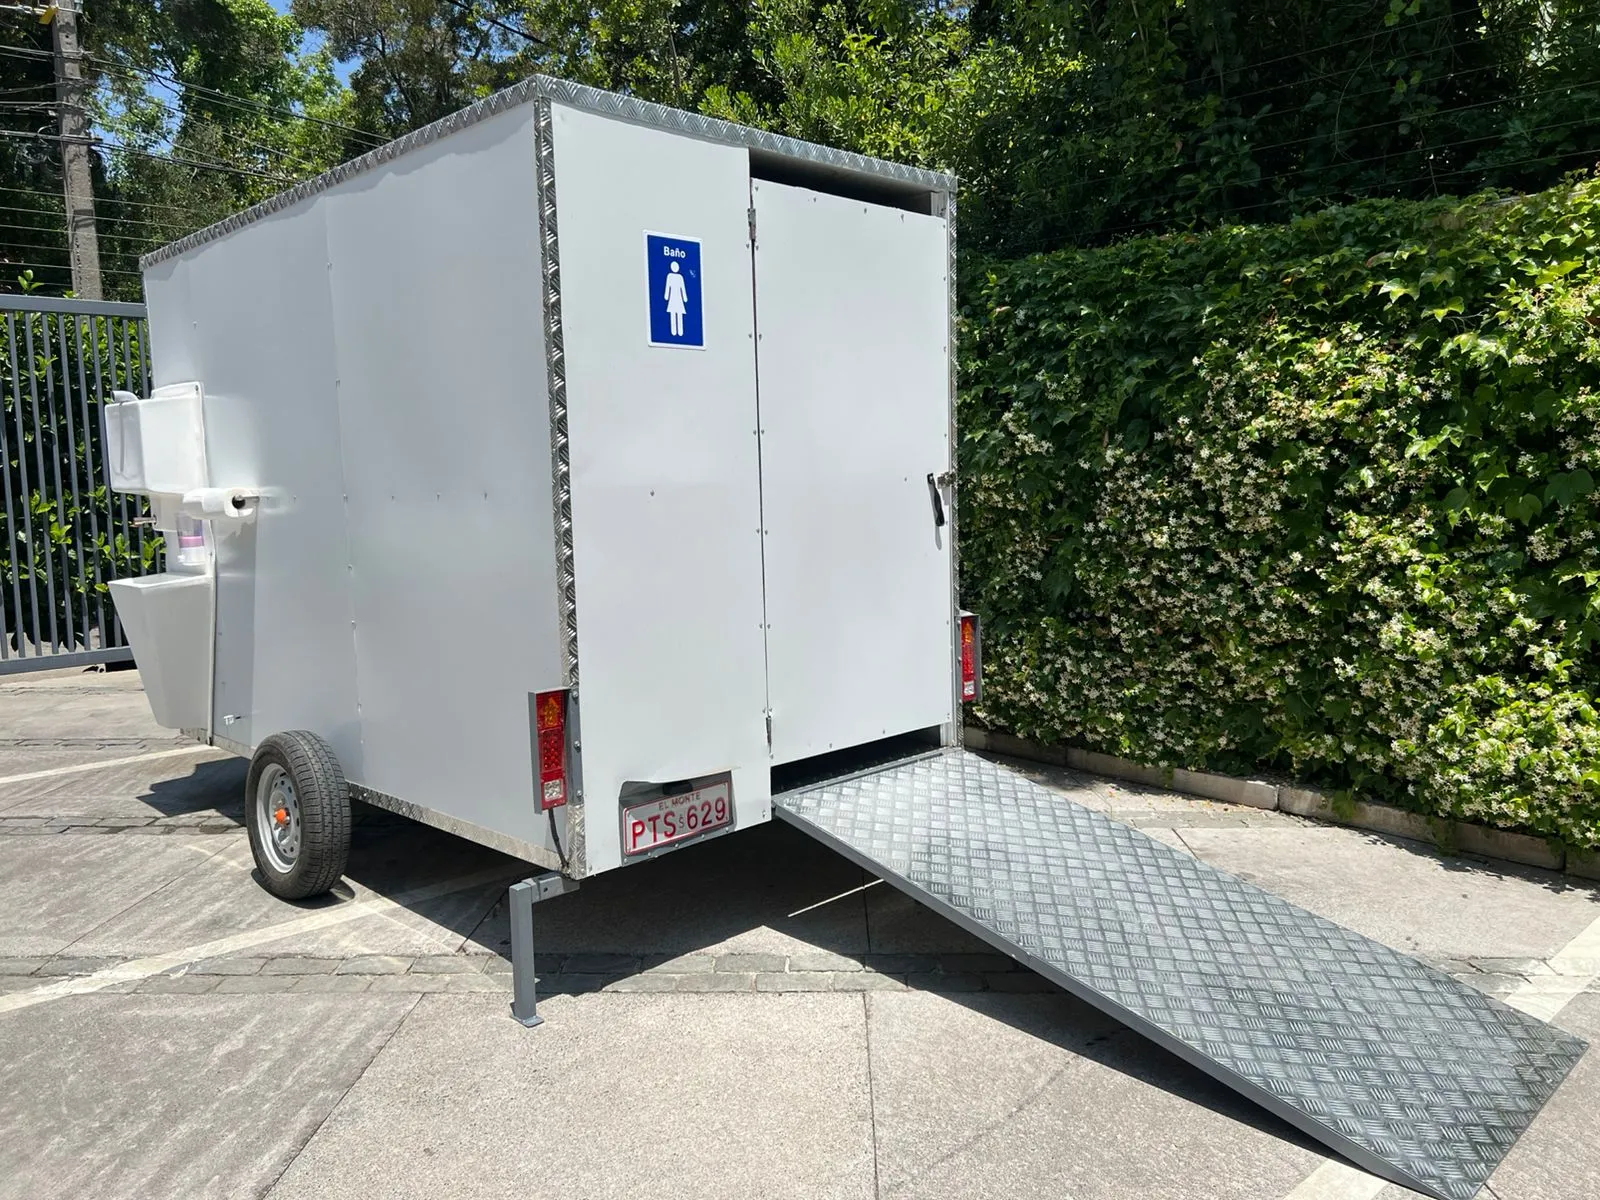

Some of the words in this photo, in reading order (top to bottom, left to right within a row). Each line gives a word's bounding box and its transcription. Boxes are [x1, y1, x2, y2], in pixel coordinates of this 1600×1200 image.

[663, 246, 686, 258] Baño
[659, 801, 669, 810] EL
[671, 792, 701, 806] MONTE
[632, 811, 676, 848] PTS
[687, 797, 725, 830] 629
